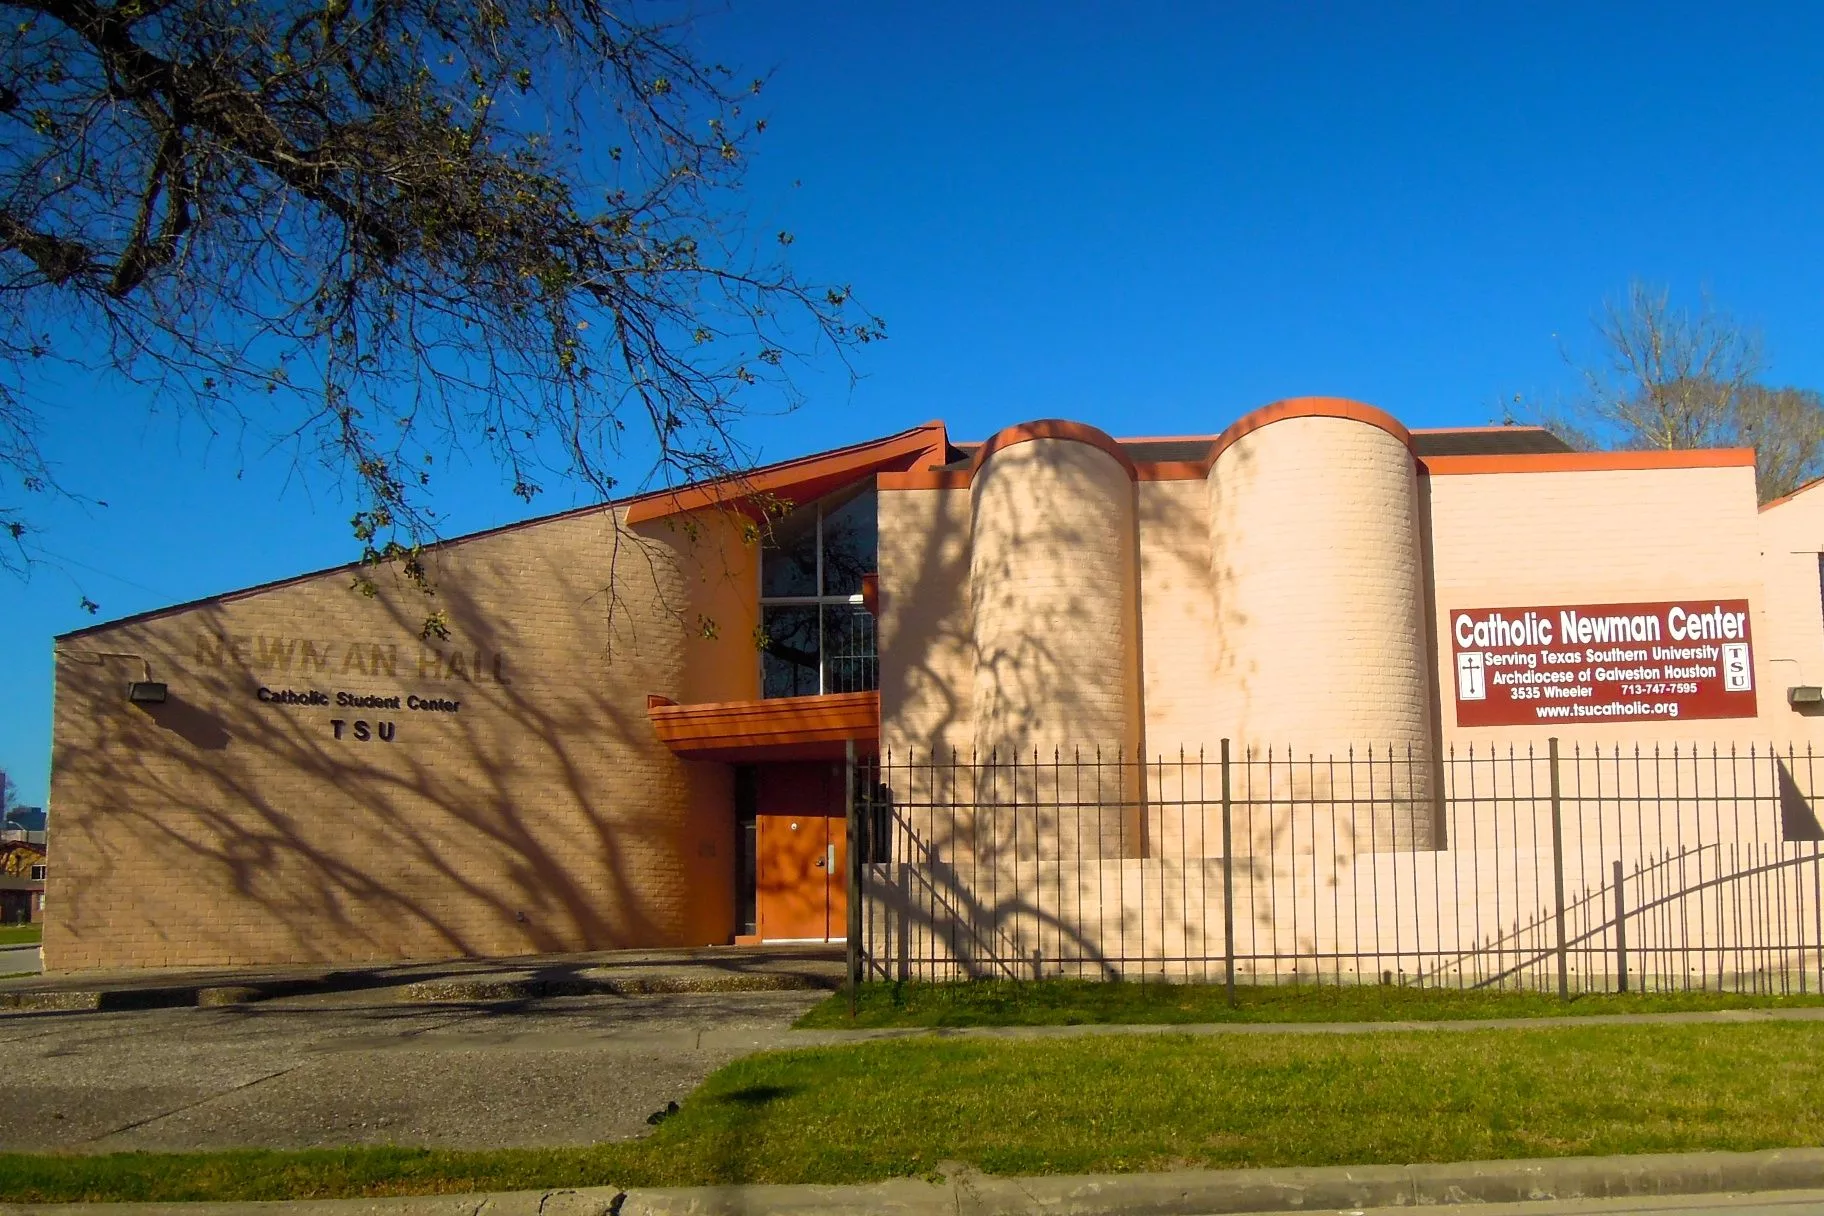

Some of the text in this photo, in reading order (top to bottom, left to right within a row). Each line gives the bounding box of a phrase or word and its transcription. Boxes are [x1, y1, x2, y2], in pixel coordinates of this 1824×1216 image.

[1455, 605, 1746, 648] Catholic Newman Center
[418, 648, 512, 685] HALL
[1485, 645, 1719, 668] Serving Texas Southern University
[1728, 648, 1745, 687] TSU
[1493, 665, 1716, 685] Archdiocese of Galveston Houston
[257, 687, 461, 713] Catholic Student Center
[1510, 683, 1697, 699] 3535 Wheeler 713-747-7595
[1536, 701, 1679, 718] www.tsucatholic.org
[330, 719, 396, 742] TSU
